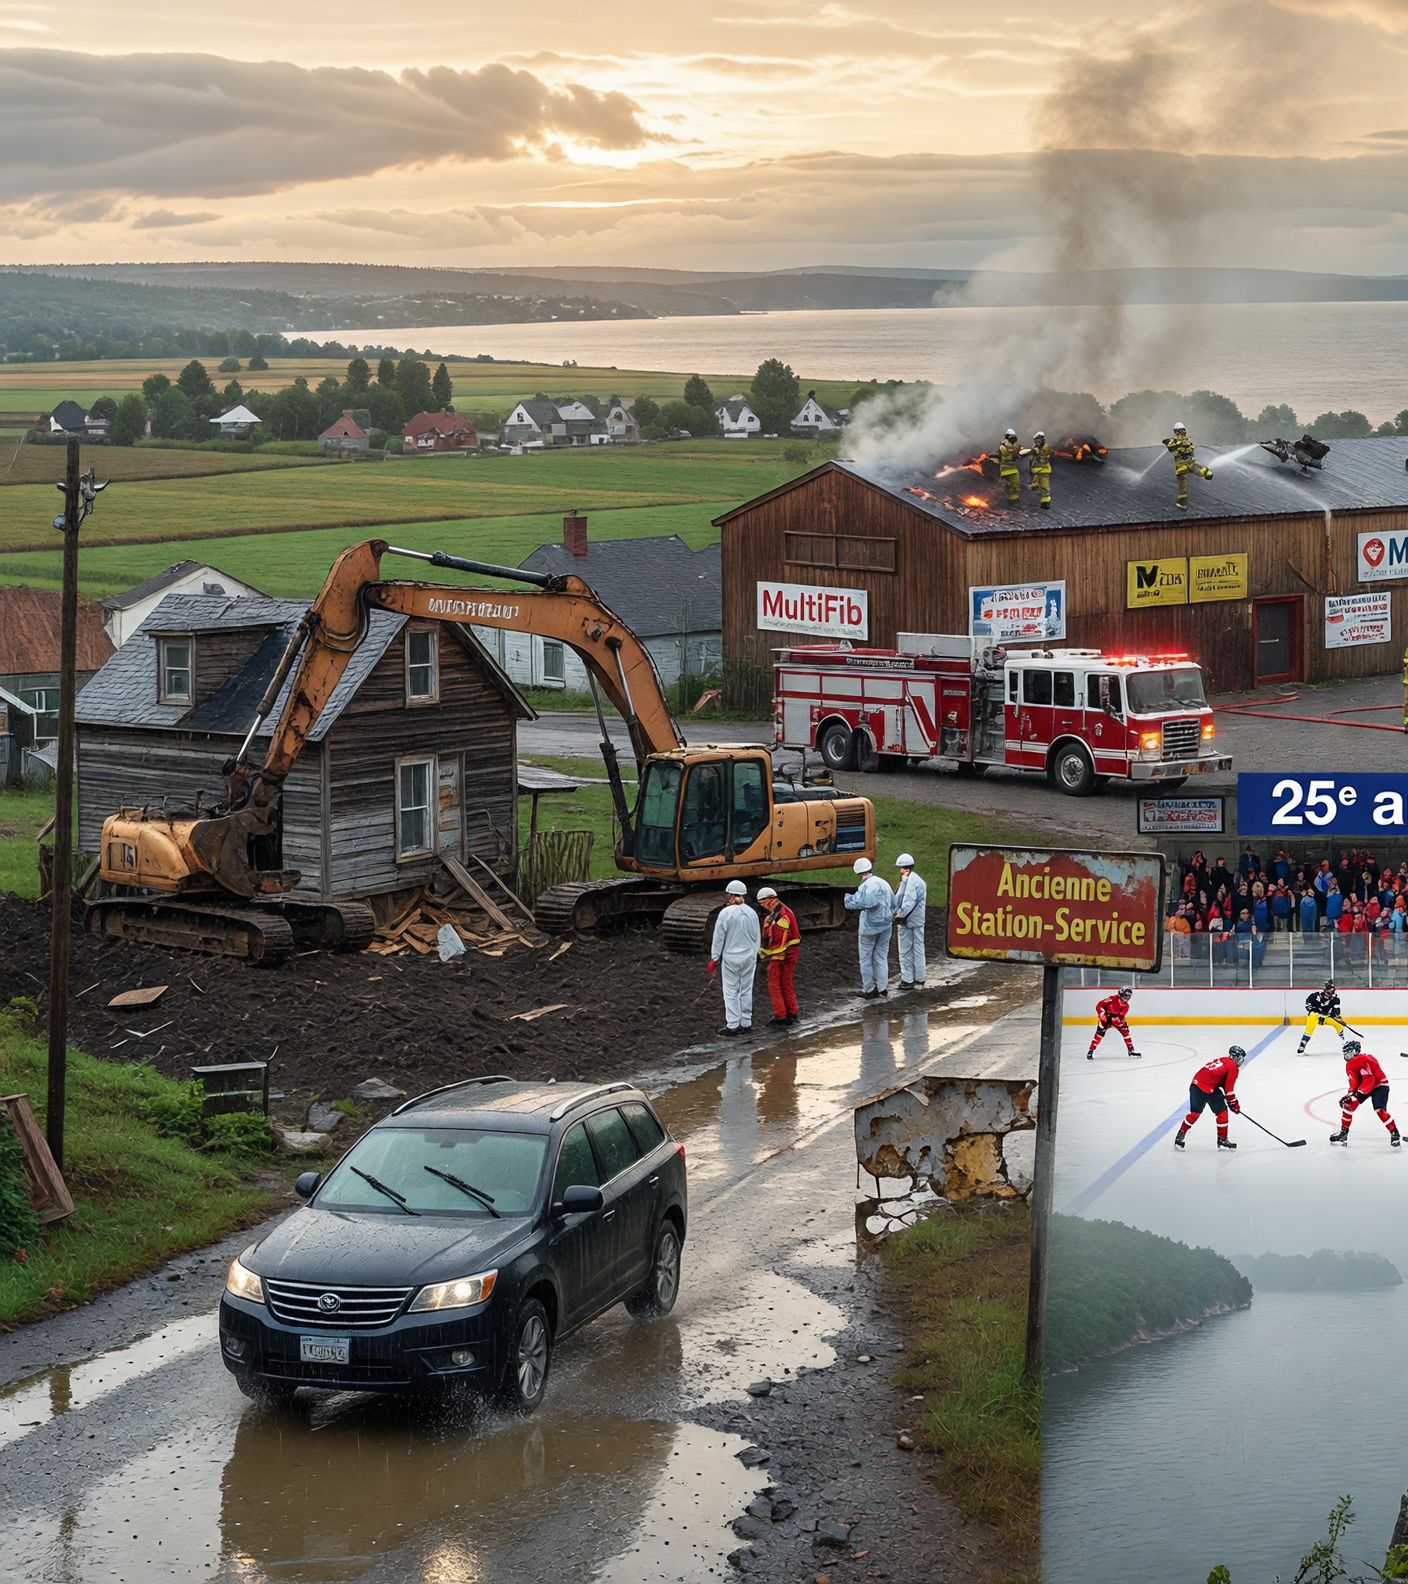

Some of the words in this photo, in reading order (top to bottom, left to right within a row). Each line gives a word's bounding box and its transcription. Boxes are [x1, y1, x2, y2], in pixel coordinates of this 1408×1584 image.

[762, 589, 864, 626] MultiFib
[996, 862, 1113, 903] Ancienne
[956, 901, 1146, 946] Station-Service
